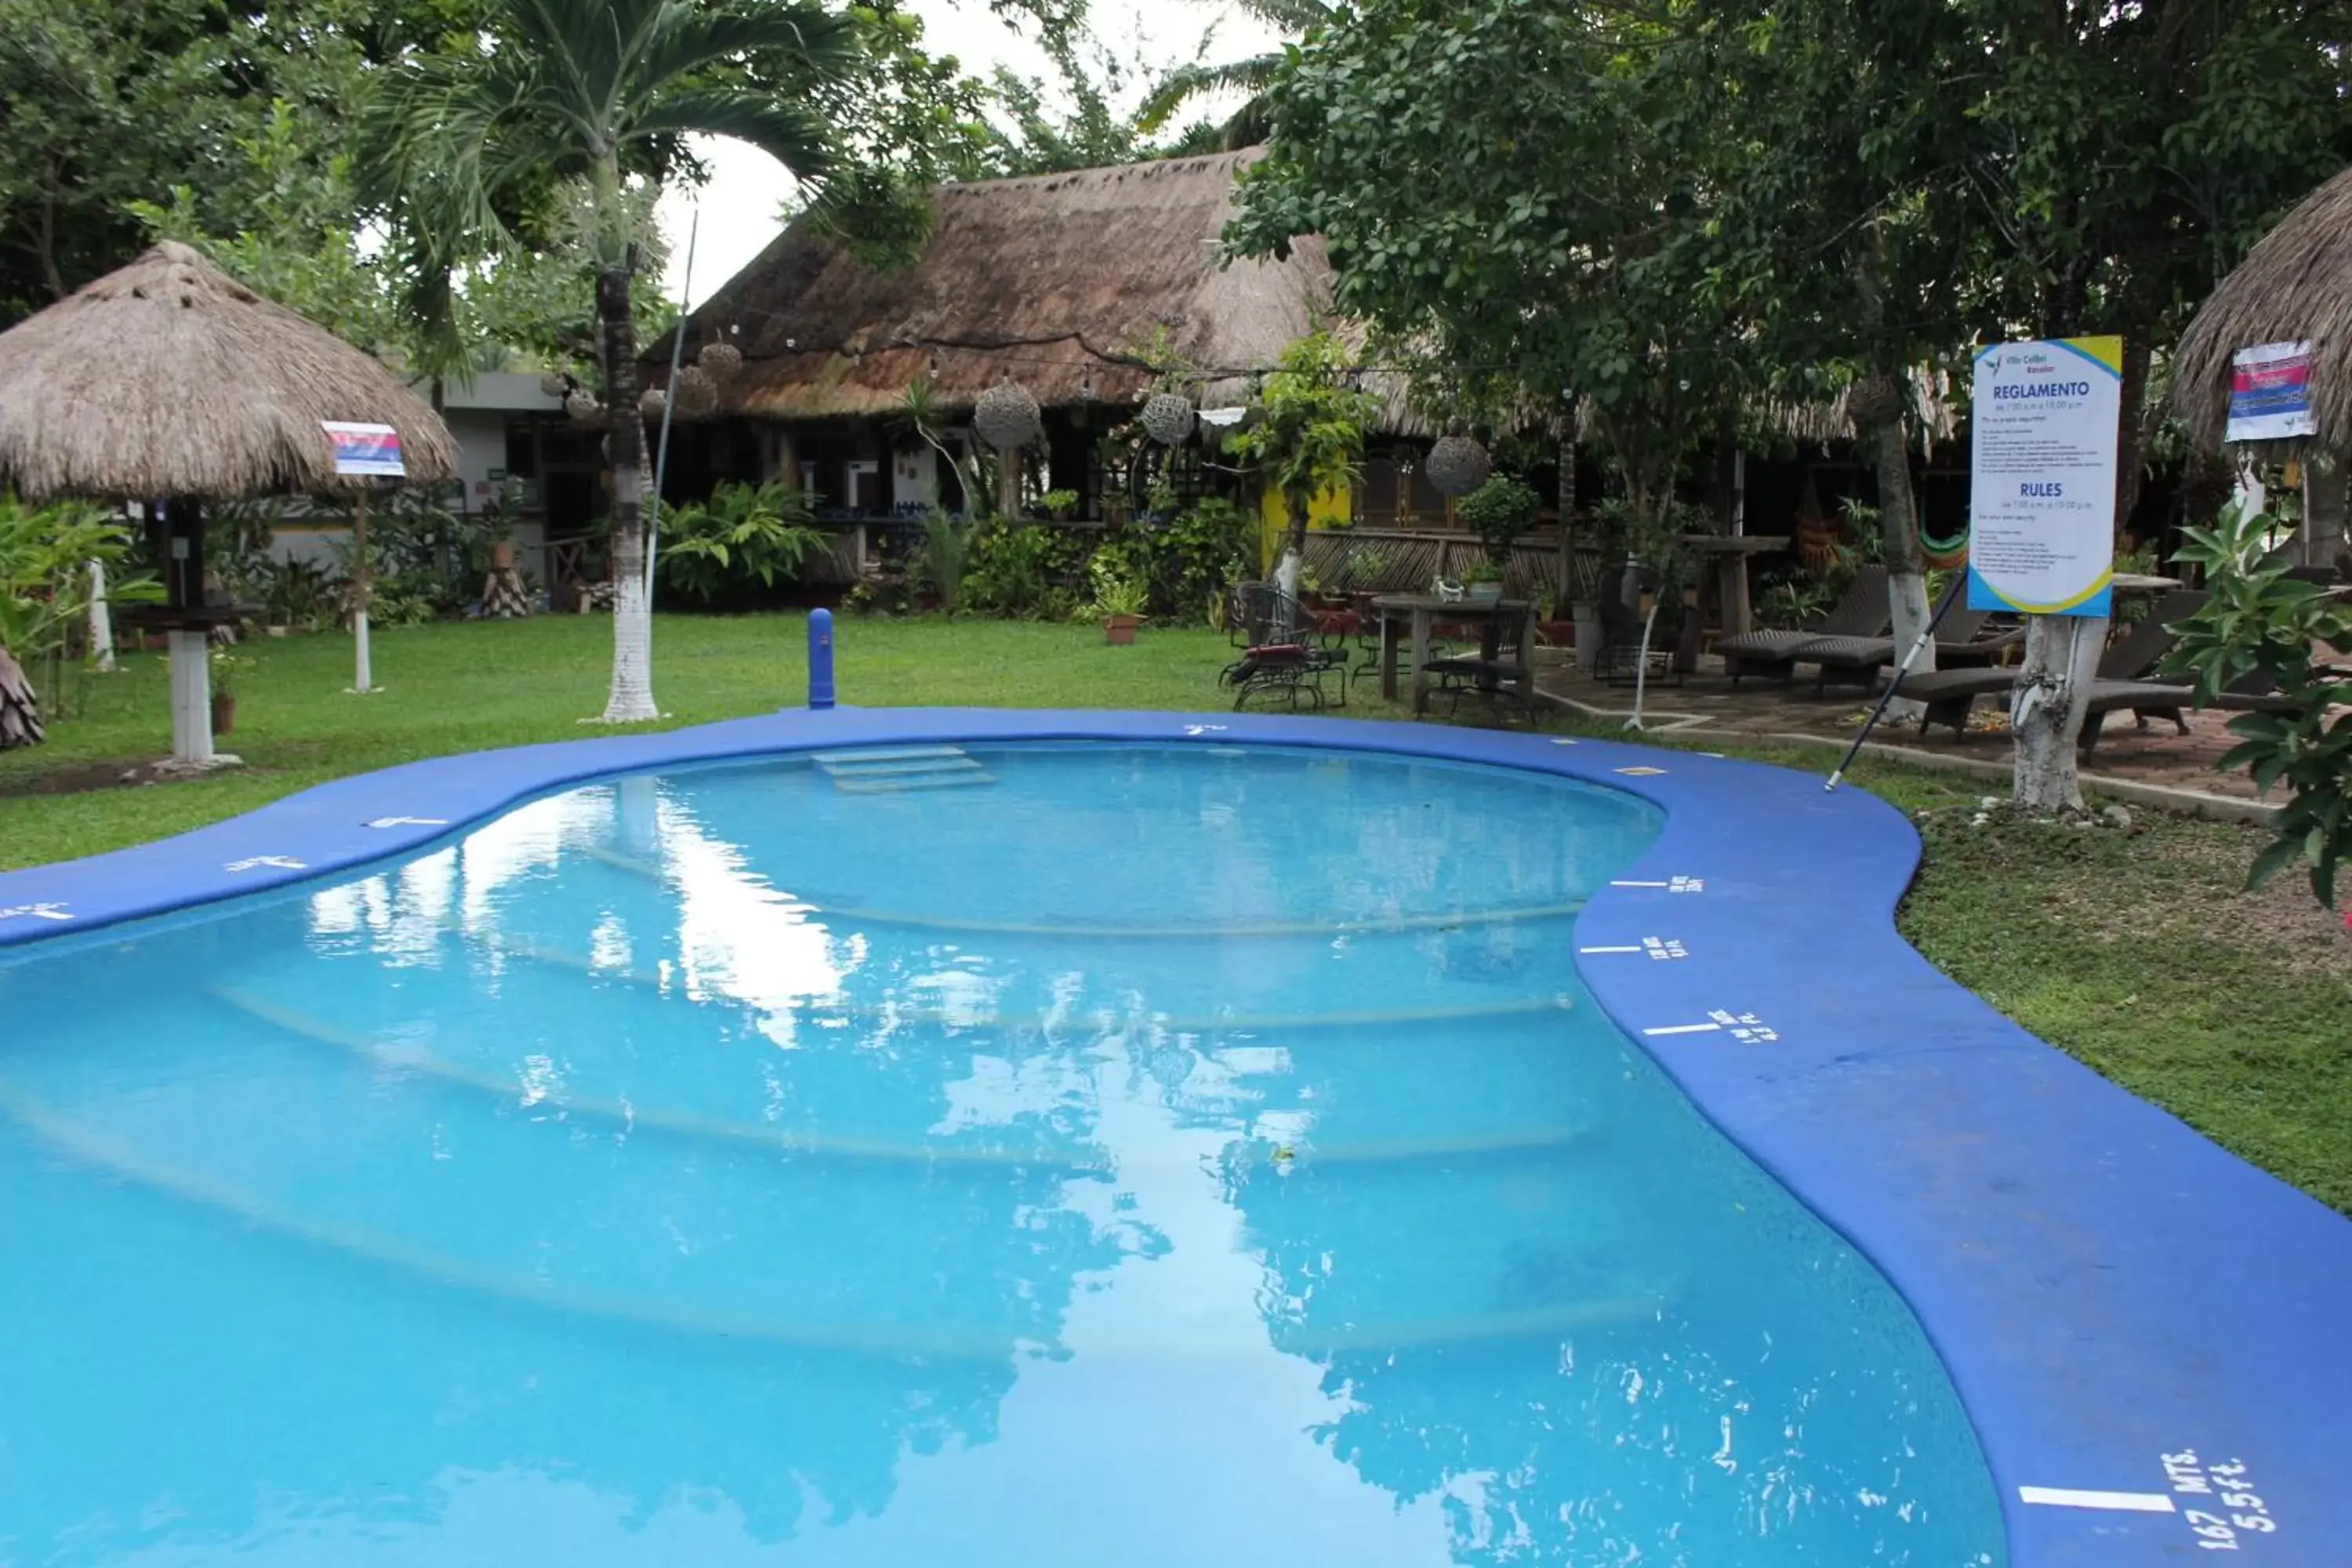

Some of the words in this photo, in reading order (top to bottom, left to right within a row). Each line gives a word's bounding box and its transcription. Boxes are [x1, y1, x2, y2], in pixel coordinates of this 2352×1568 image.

[1993, 381, 2090, 400] REGLAMENTO
[2020, 483, 2062, 497] RULES
[2160, 1448, 2213, 1494] MTS.
